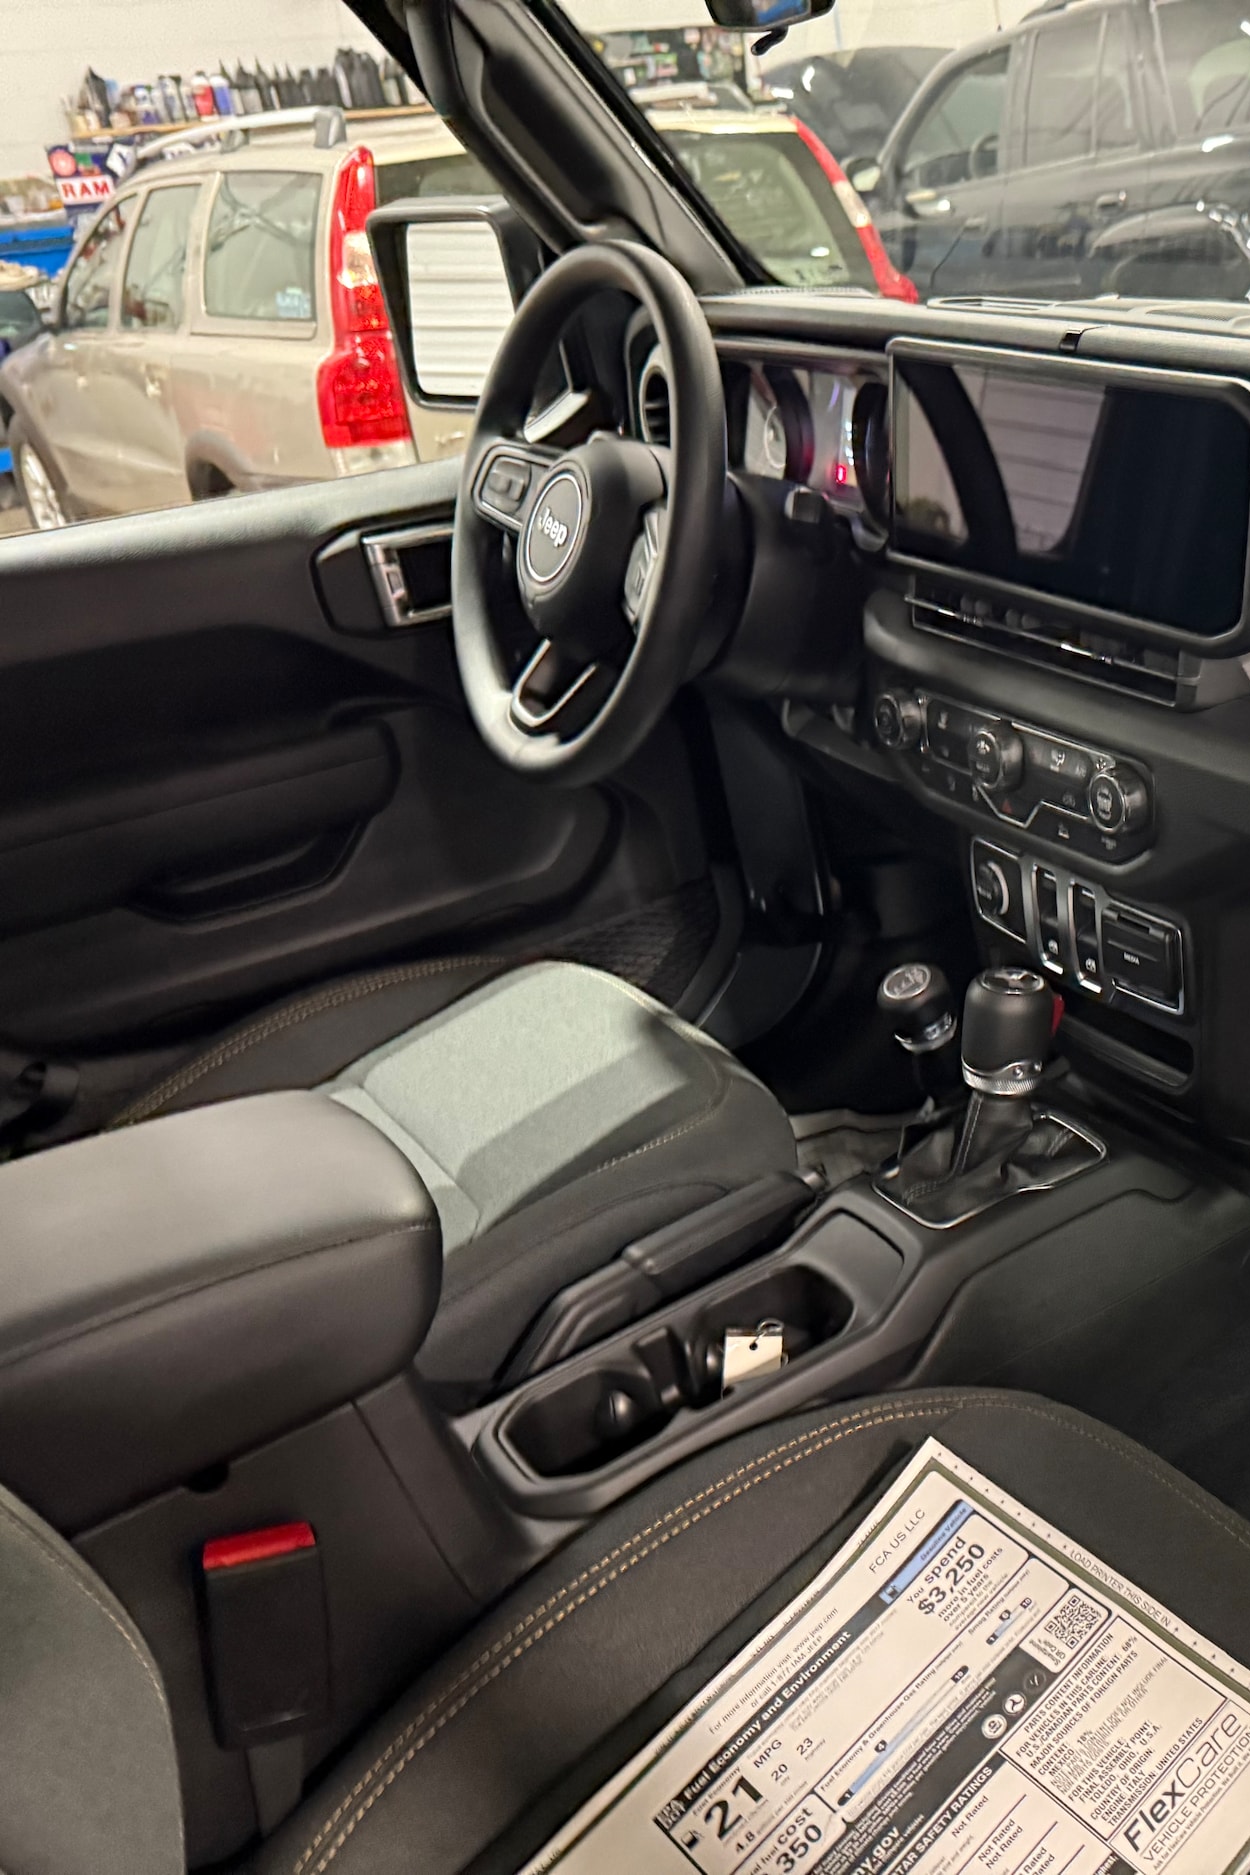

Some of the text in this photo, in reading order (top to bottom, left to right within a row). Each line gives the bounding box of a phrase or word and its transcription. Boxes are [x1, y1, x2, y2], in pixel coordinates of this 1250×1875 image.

[61, 180, 111, 199] RAM
[538, 506, 568, 548] Jeep
[867, 1507, 927, 1573] FCA US LLC
[905, 1535, 969, 1604] You spend
[914, 1541, 990, 1618] $3,250
[937, 1595, 960, 1618] more
[957, 1585, 968, 1596] in
[965, 1568, 983, 1586] fuel
[980, 1546, 1004, 1570] costs
[942, 1602, 962, 1622] over
[960, 1595, 968, 1603] 5
[966, 1572, 990, 1597] years
[1069, 1548, 1172, 1627] LOAD PRINTER THIS SIDE IN
[967, 1595, 1005, 1635] Smog Rating
[1023, 1632, 1115, 1733] PARTS CONTENT INFORMATION
[1053, 1647, 1067, 1660] QR
[682, 1770, 711, 1801] Fuel
[707, 1716, 764, 1776] Economy
[758, 1695, 785, 1722] and
[780, 1627, 852, 1702] Environment
[708, 1719, 723, 1735] For
[721, 1702, 741, 1722] more
[738, 1665, 777, 1705] information
[820, 1667, 936, 1791] Fuel Economy & Greenhouse Gas Rating
[1015, 1739, 1032, 1757] FOR
[1028, 1707, 1061, 1743] VEHICLES
[1057, 1699, 1069, 1710] IN
[1064, 1683, 1083, 1702] THIS
[1024, 1705, 1074, 1759] U.S./CANADIAN
[1070, 1683, 1094, 1708] PARTS
[1029, 1649, 1138, 1769] MAJOR SOURCES OF FOREIGN PARTS
[769, 1761, 789, 1782] 20
[794, 1735, 814, 1755] 23
[1075, 1727, 1093, 1746] 18%
[1078, 1718, 1153, 1803] FINAL ASSEMBLY POINT:
[699, 1773, 764, 1841] 21
[751, 1737, 783, 1770] MPG
[1067, 1783, 1086, 1802] FOR
[1081, 1766, 1100, 1786] THIS
[1089, 1770, 1120, 1805] TOLEDO,
[1117, 1747, 1140, 1772] OHIO,
[1089, 1783, 1122, 1821] COUNTRY
[1118, 1772, 1132, 1786] OF
[1107, 1768, 1159, 1828] TRANSMISSION:
[1155, 1742, 1181, 1772] UNITED
[1177, 1716, 1204, 1745] STATES
[1118, 1708, 1245, 1853] FlexCare
[1124, 1768, 1147, 1792] ITALY
[757, 1804, 814, 1866] fuel cost
[914, 1809, 954, 1854] SAFETY
[949, 1764, 994, 1813] RATINGS
[950, 1819, 968, 1838] Not
[964, 1794, 989, 1821] Rated
[977, 1817, 1016, 1862] Not Rated
[1142, 1805, 1193, 1864] VEHICLE
[984, 1824, 1023, 1869] Not Rated
[1022, 1845, 1048, 1874] Rated
